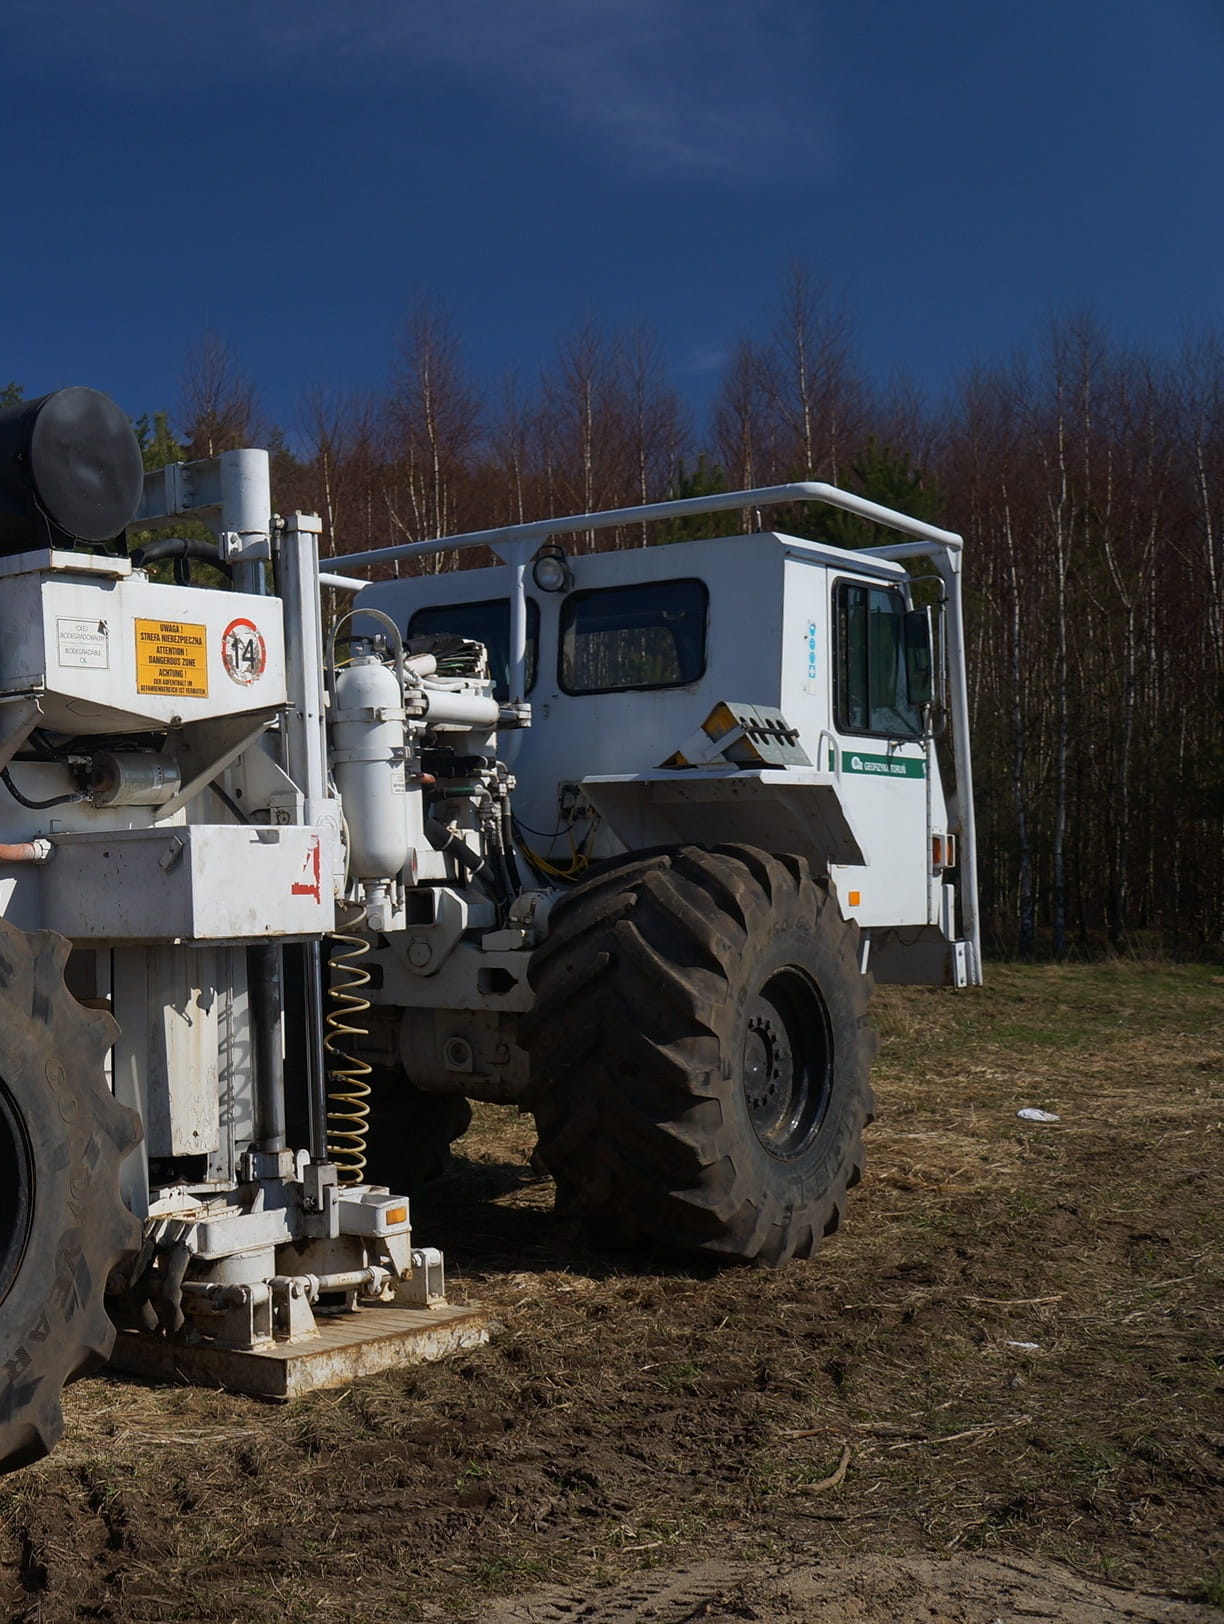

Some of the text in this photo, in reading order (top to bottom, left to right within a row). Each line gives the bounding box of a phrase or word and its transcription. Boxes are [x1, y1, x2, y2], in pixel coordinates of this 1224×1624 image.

[160, 623, 180, 634] UWAGA
[140, 632, 203, 646] STREFA NIEBEZPIECZNA
[156, 646, 185, 656] ATTENTION
[231, 637, 256, 670] 14
[148, 655, 196, 668] DANGEROUS ZONE
[158, 668, 184, 678] ACHTUNG
